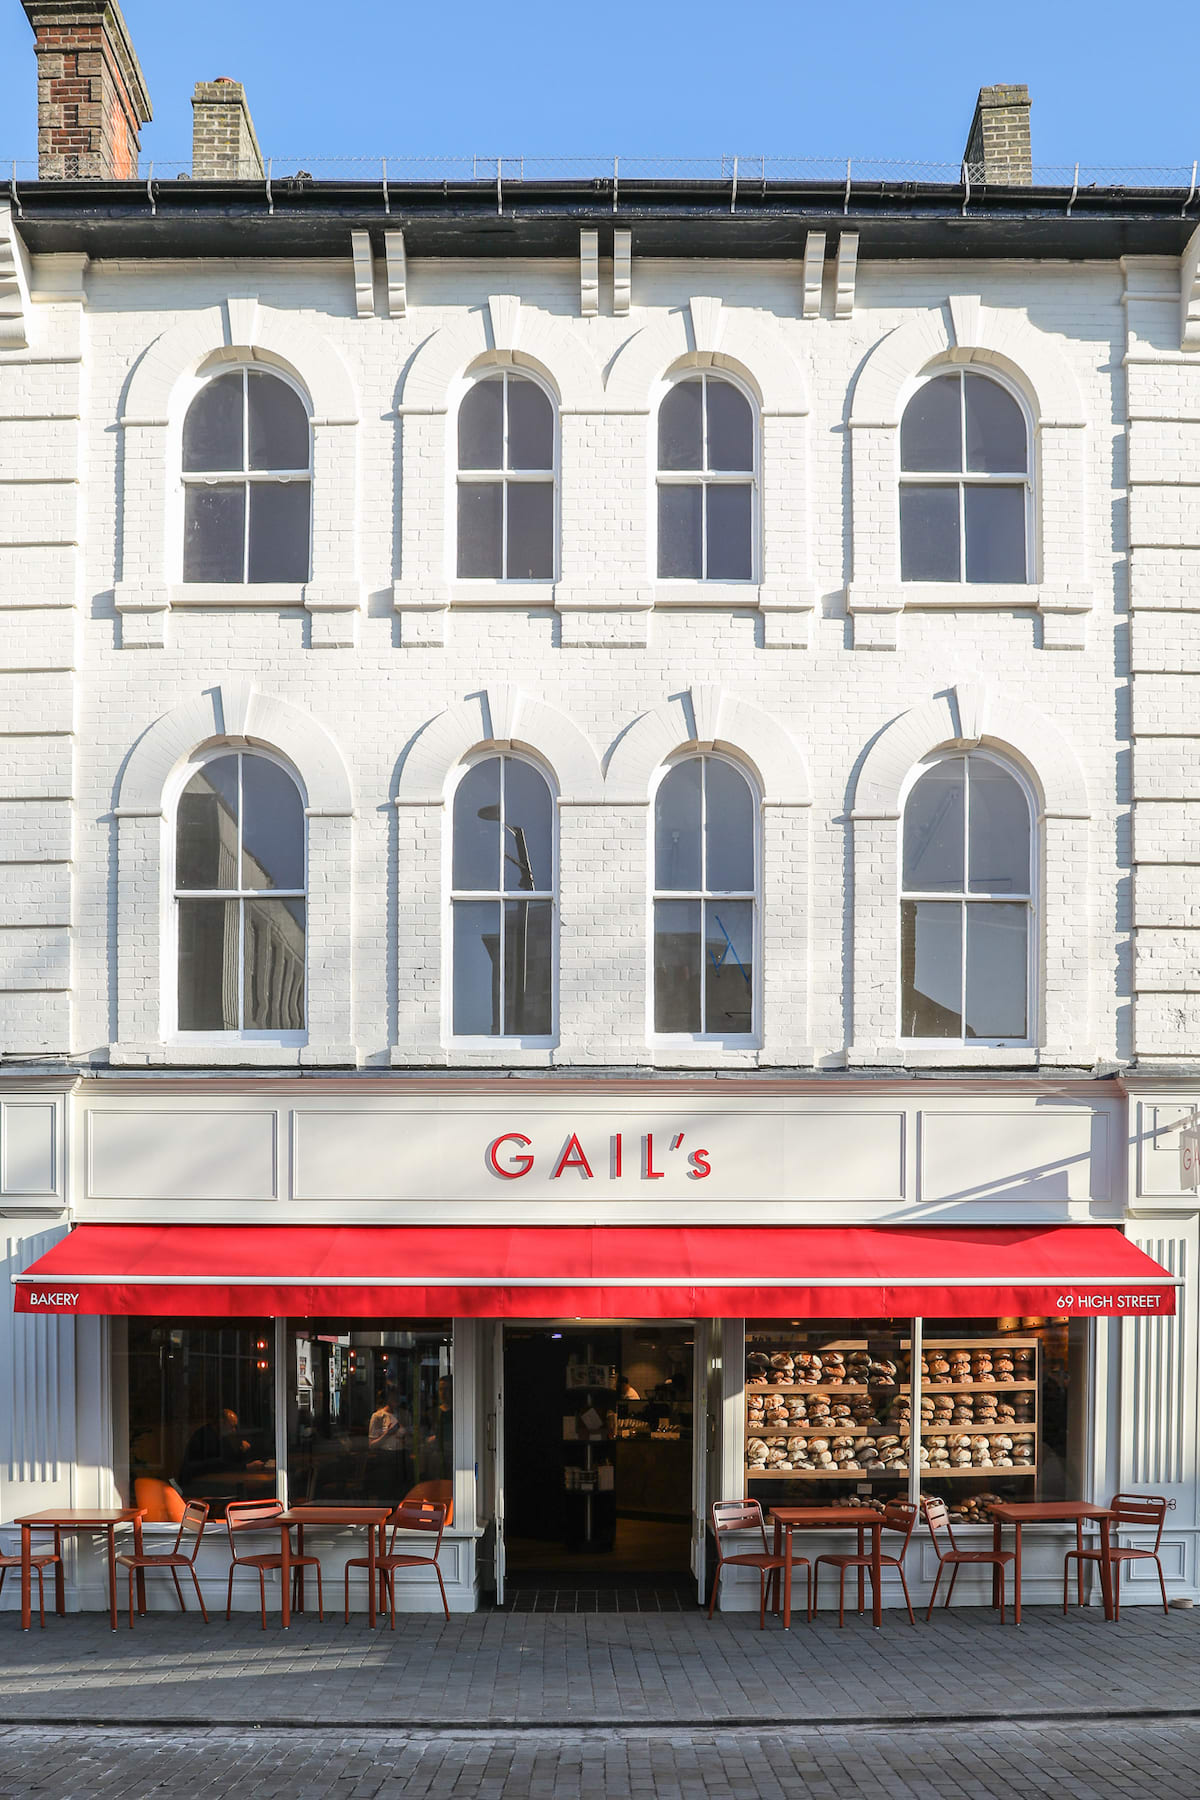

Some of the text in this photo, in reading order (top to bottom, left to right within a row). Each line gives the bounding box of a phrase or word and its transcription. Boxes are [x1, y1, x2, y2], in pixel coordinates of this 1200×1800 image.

[489, 1132, 712, 1179] GAIL's
[30, 1293, 79, 1306] BAKERY
[1056, 1295, 1161, 1308] 69 HIGH STREET
